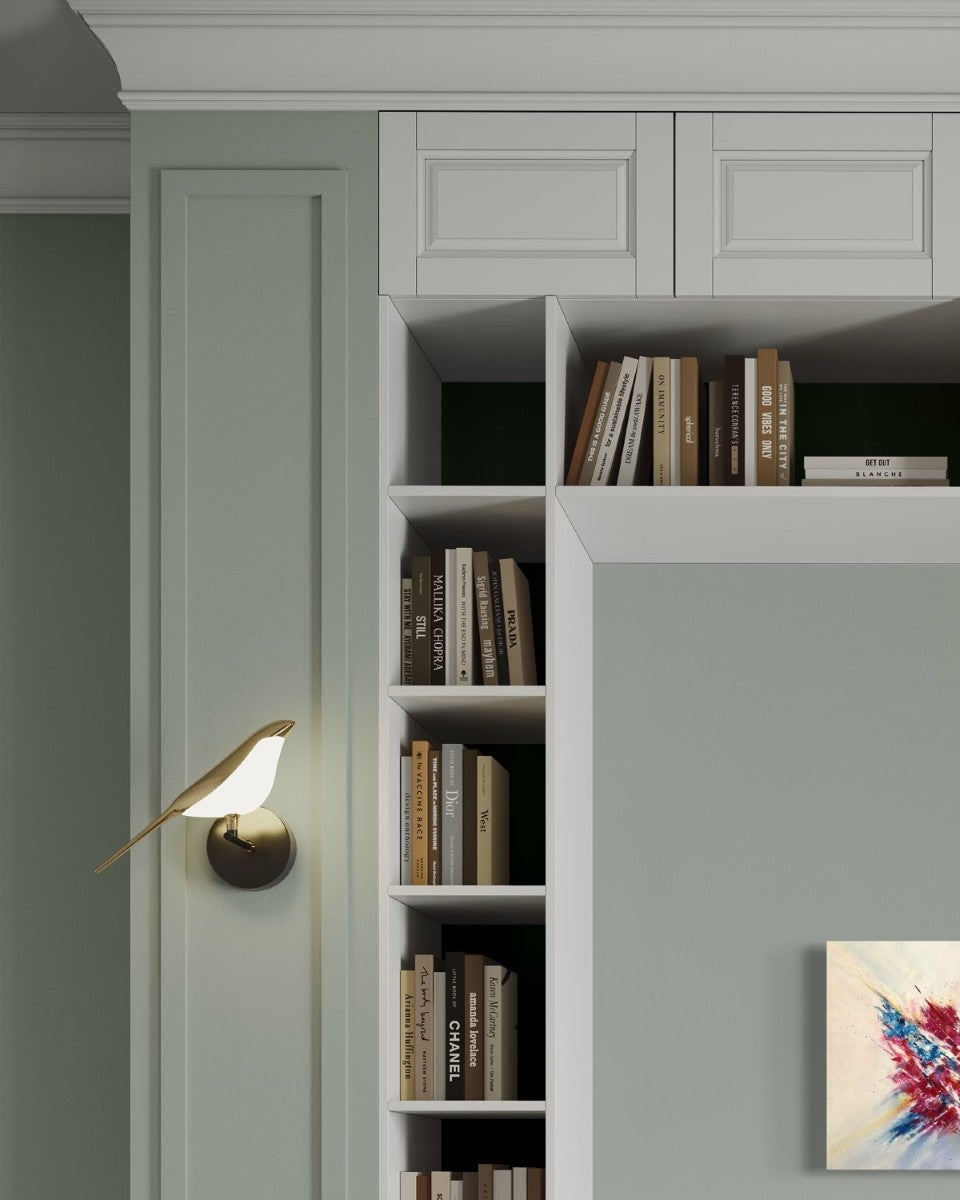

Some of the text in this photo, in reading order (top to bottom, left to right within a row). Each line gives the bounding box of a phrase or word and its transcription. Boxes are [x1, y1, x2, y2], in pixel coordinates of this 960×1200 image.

[658, 375, 665, 386] ON
[611, 398, 623, 432] sustainable
[620, 374, 630, 397] lifestyle
[779, 404, 787, 415] IN
[596, 413, 604, 432] GOOD
[625, 439, 634, 464] DREAM
[635, 393, 643, 417] AWAKE
[684, 416, 694, 444] spherical
[762, 386, 772, 459] GOOD VIBES ONLY
[404, 621, 411, 630] ME
[416, 616, 426, 639] STILL
[434, 575, 443, 671] MALLIKA CHOPRA
[476, 576, 494, 677] Sigrid Rausing mayhem
[507, 610, 516, 648] PRADA
[445, 790, 458, 817] Dior
[480, 810, 488, 832] West
[490, 976, 498, 998] Karen
[469, 992, 478, 1067] amanda lovelace
[487, 1000, 498, 1038] McCartney
[403, 1032, 413, 1079] Huffington
[449, 1020, 460, 1082] CHANEL
